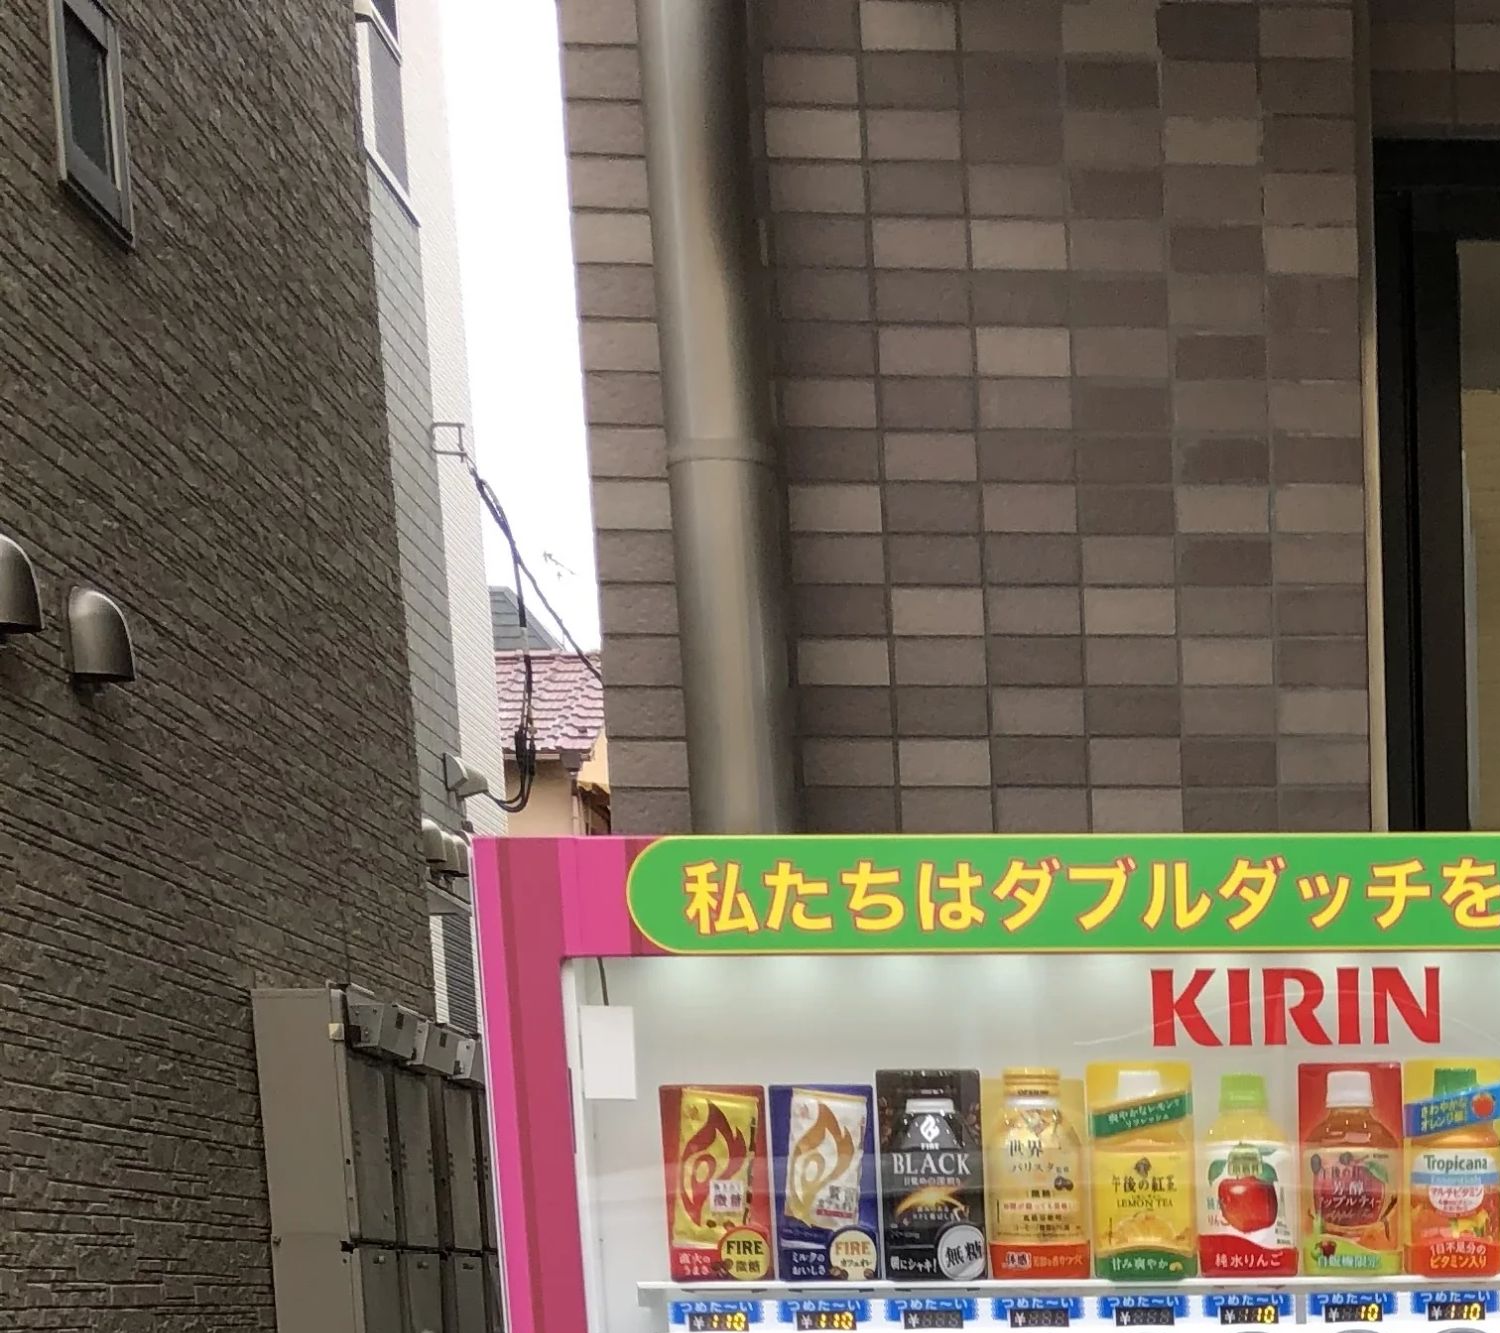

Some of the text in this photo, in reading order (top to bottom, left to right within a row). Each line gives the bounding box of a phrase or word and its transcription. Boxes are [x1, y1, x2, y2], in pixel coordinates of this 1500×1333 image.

[1151, 966, 1441, 1046] KIRIN
[893, 1153, 970, 1176] BLACK
[1424, 1155, 1487, 1172] Tropicana
[1112, 1174, 1177, 1193] 午後の紅茶
[1117, 1198, 1173, 1209] LEMON TEA
[727, 1241, 763, 1256] FIRE
[835, 1241, 870, 1256] FIRE
[945, 1241, 982, 1268] 無糖
[1430, 1243, 1486, 1257] 1日不足分の
[792, 1252, 825, 1264] ミルクの
[1215, 1253, 1281, 1268] 純水りんご
[1430, 1256, 1487, 1269] ビタミン入り
[736, 1260, 761, 1273] 微糖
[793, 1265, 826, 1276] おいしさ
